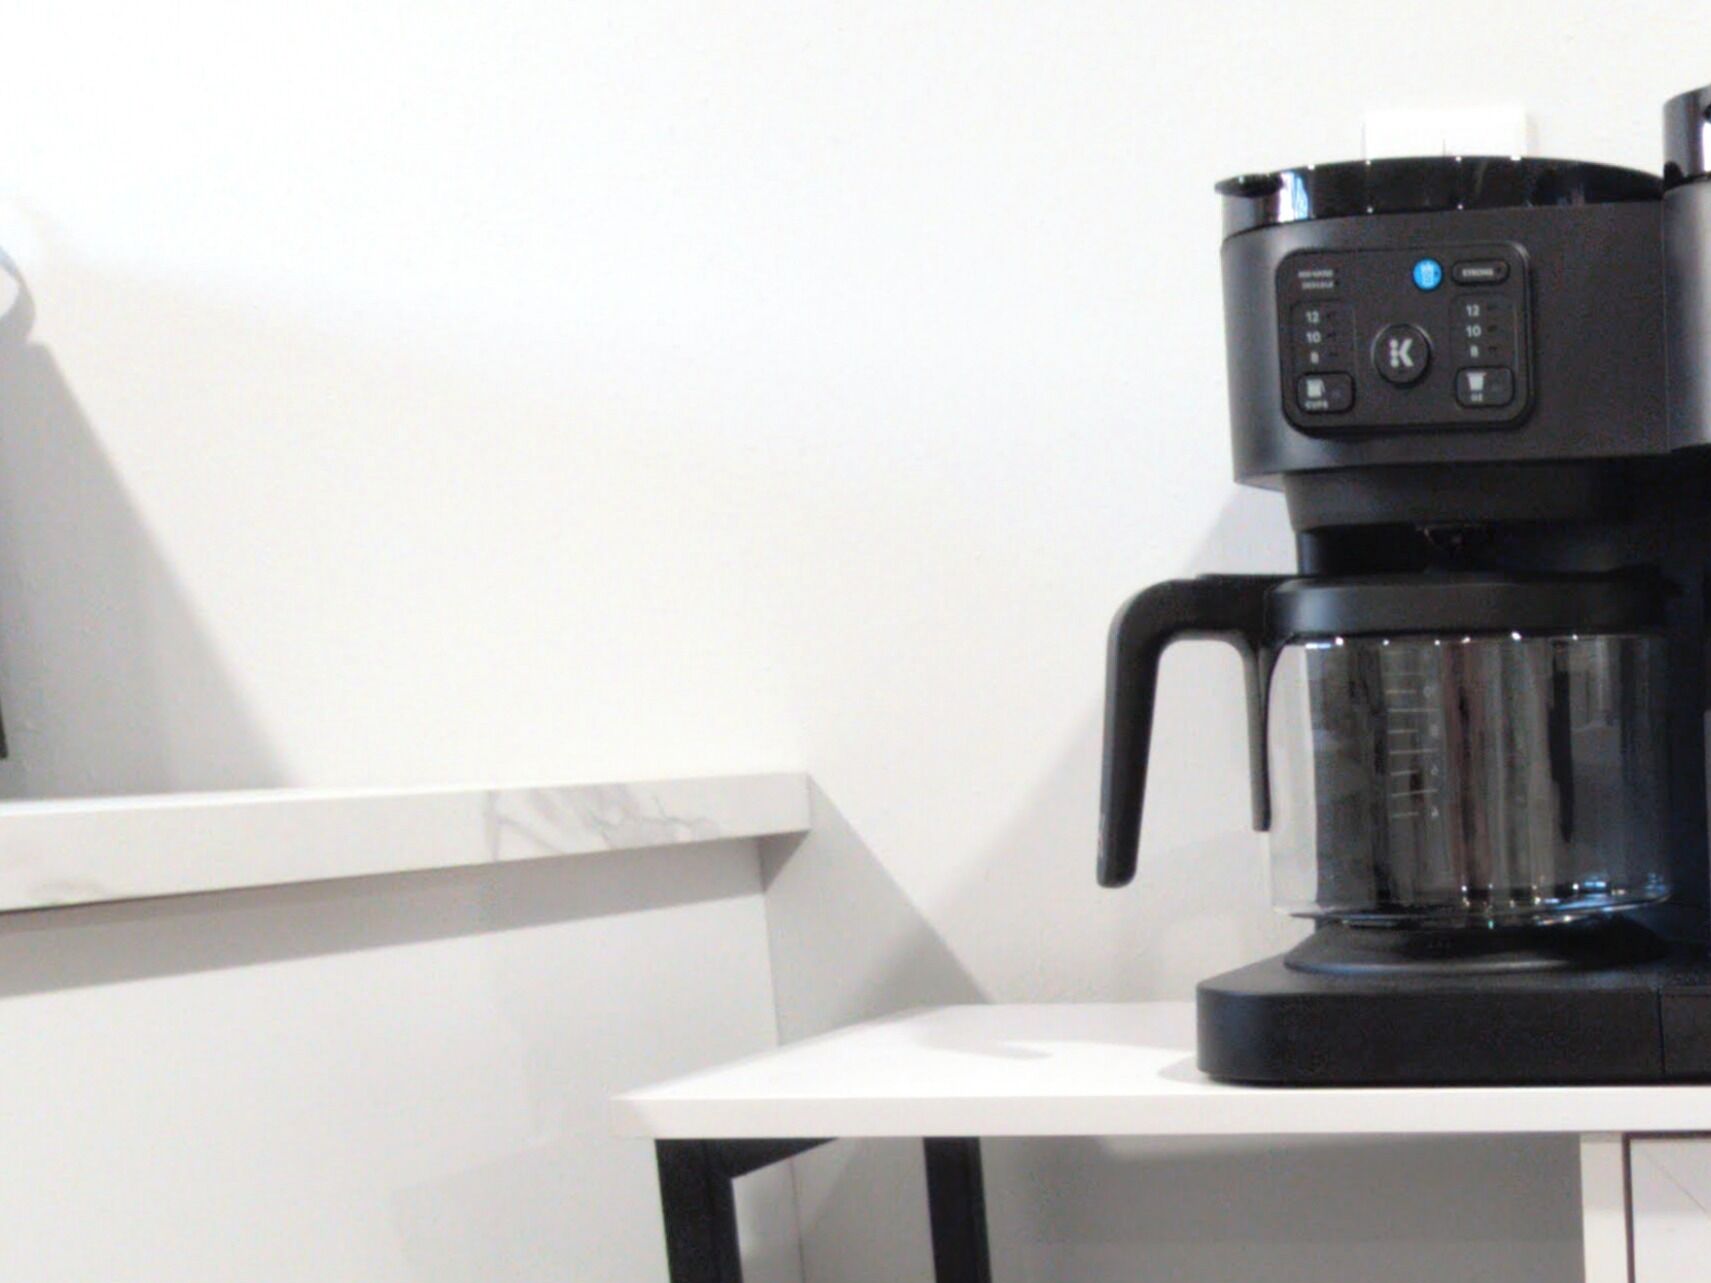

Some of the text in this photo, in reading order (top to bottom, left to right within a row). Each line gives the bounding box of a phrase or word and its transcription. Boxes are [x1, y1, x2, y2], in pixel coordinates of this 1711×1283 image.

[1305, 310, 1320, 323] 12
[1465, 304, 1480, 317] 12
[1305, 331, 1322, 344] 10
[1465, 325, 1482, 338] 10
[1389, 338, 1414, 368] K
